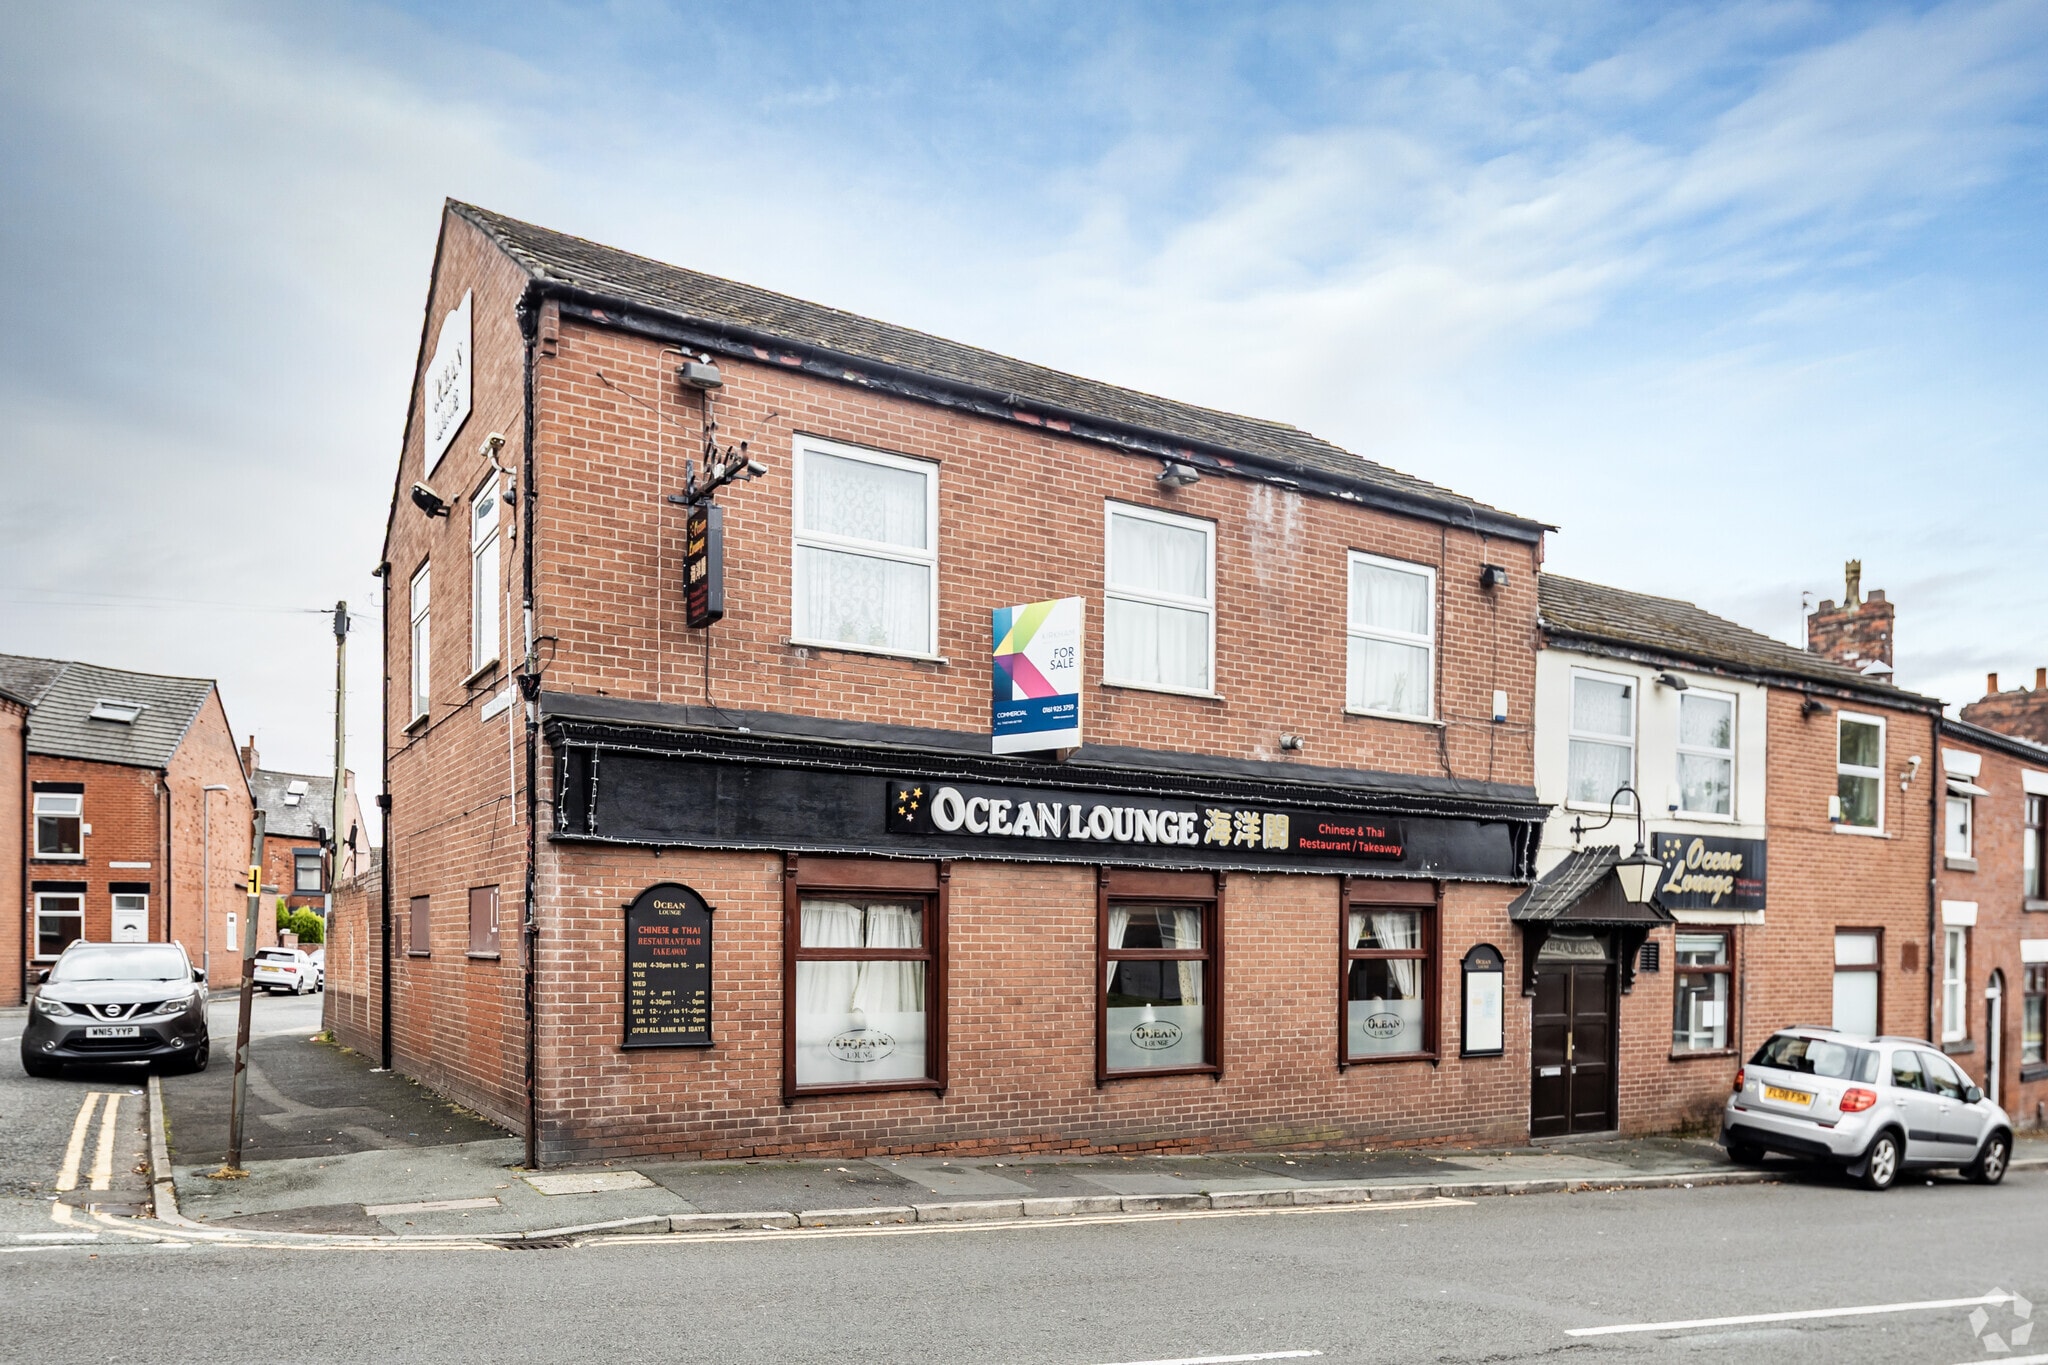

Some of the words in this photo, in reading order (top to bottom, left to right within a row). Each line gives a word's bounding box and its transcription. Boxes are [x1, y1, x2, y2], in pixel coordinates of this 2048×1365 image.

[1054, 646, 1074, 658] FOR
[1050, 657, 1074, 670] SALE
[930, 786, 1062, 838] OCEAN
[1067, 804, 1200, 846] LOUNGE
[1318, 822, 1355, 837] Chinese
[1357, 825, 1364, 837] &
[1366, 826, 1385, 838] Thai
[1299, 838, 1350, 851] Restaurant
[1358, 841, 1402, 857] Takeaway
[1686, 837, 1742, 872] Ocean
[1662, 860, 1734, 905] Lounge
[653, 900, 686, 910] OCEAN
[638, 925, 670, 935] CHINESE
[682, 926, 701, 935] THAI
[653, 947, 687, 956] TAKEAWAY
[1368, 1018, 1400, 1029] OCEAN
[115, 1027, 133, 1036] YYP
[1136, 1027, 1177, 1039] OCEAN
